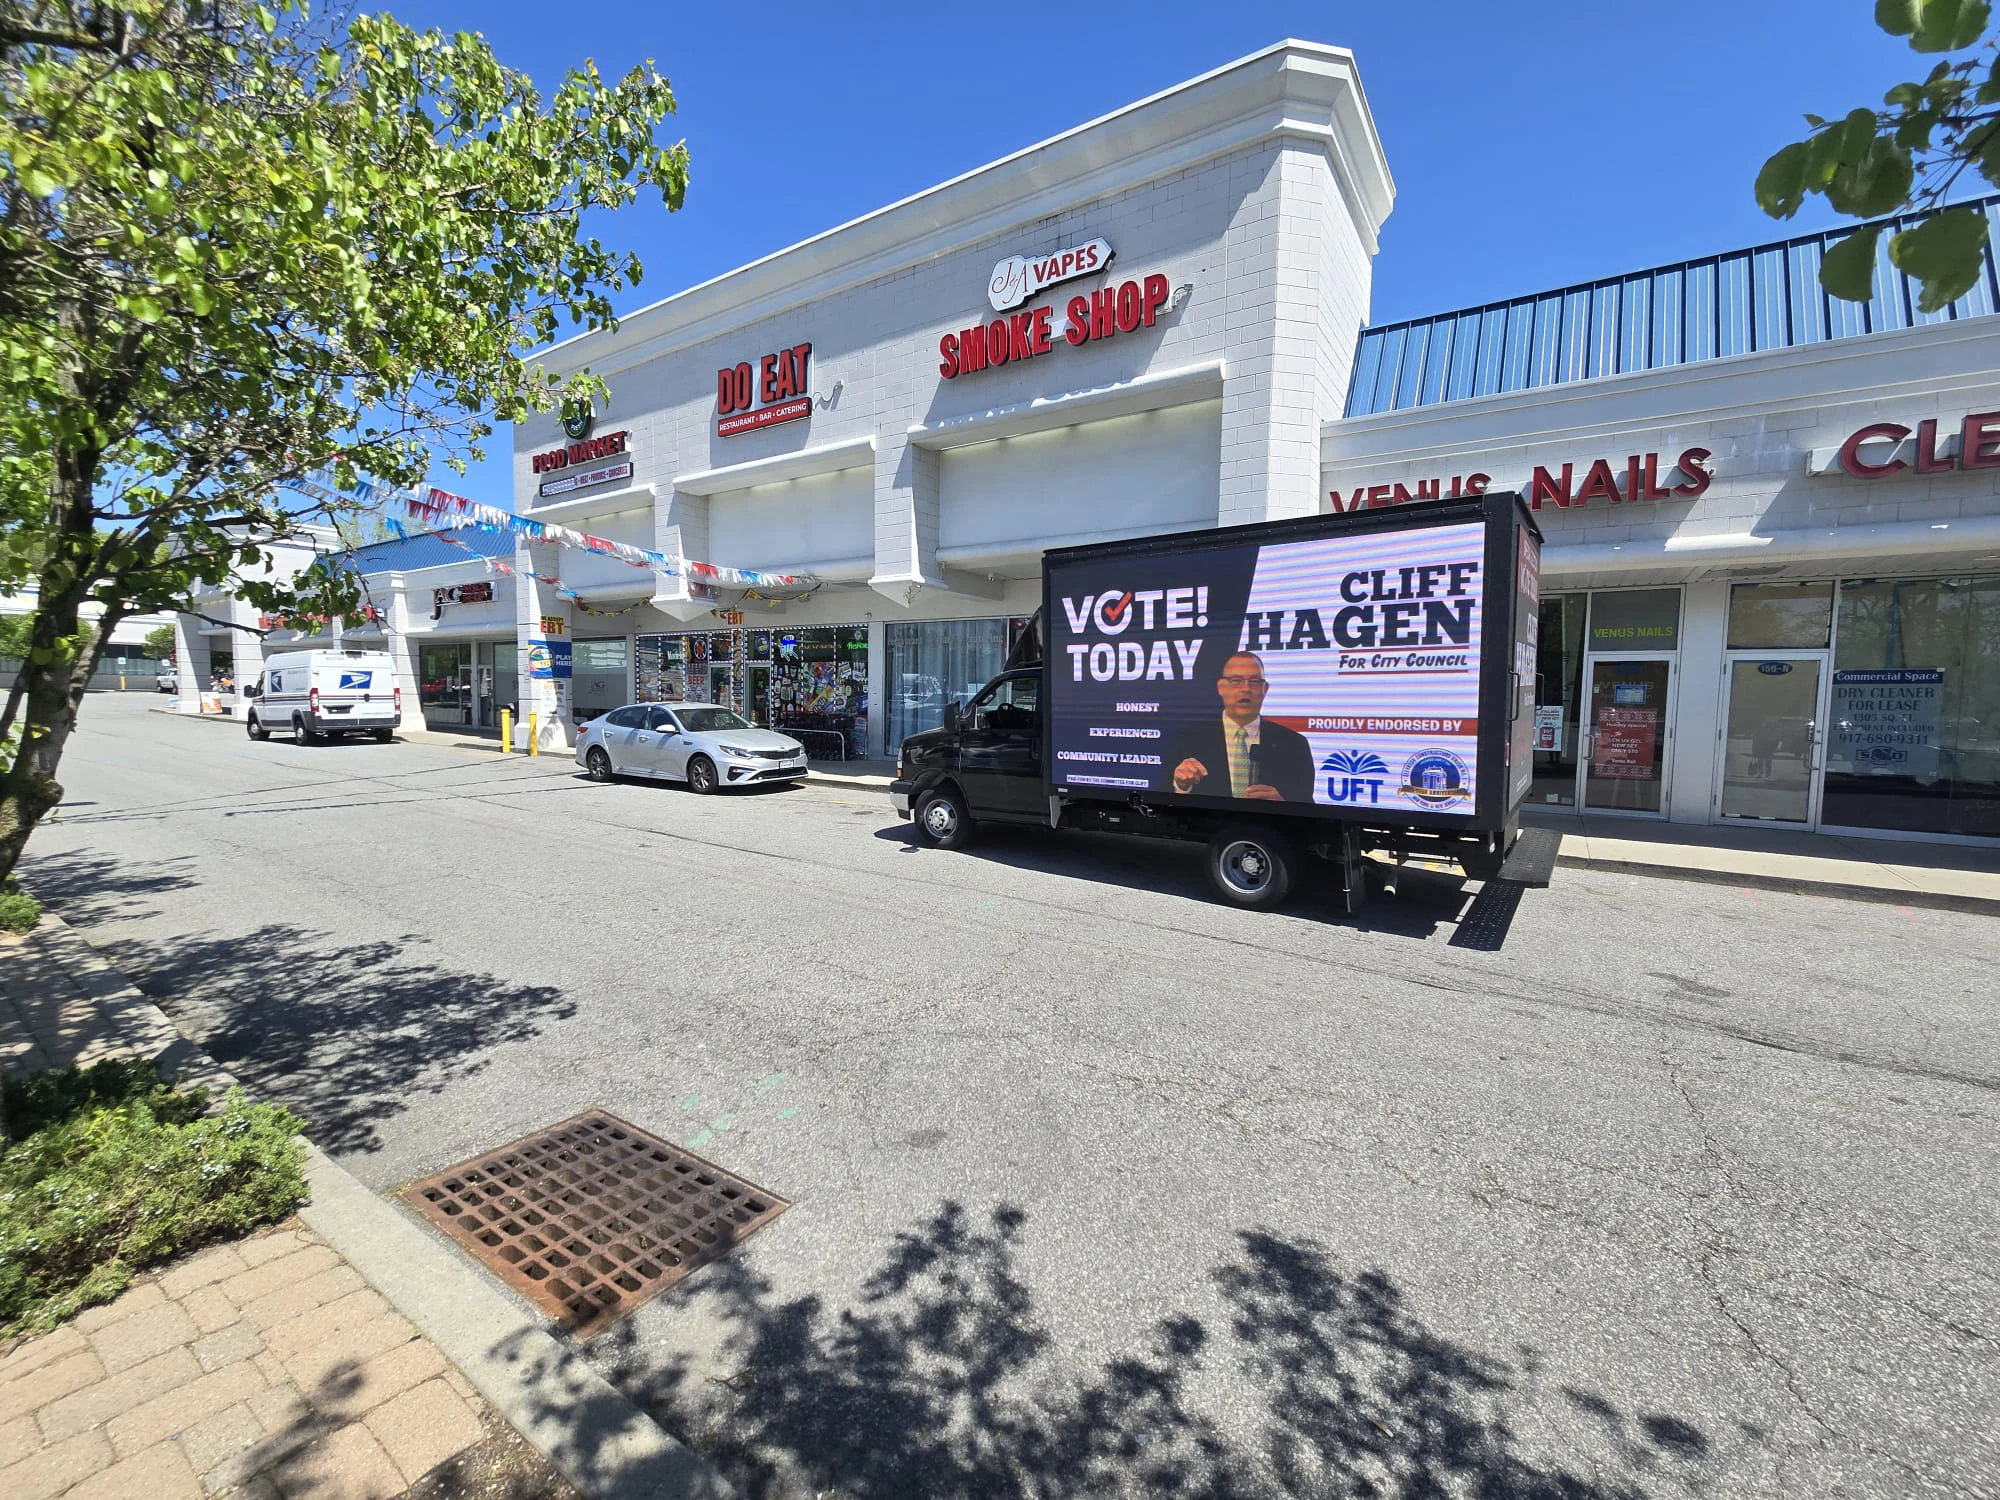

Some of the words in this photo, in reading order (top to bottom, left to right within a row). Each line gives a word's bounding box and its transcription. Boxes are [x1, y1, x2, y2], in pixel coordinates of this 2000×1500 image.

[991, 261, 1029, 304] J&A
[1033, 244, 1098, 283] VAPES
[939, 304, 1053, 380] SMOKE
[1065, 273, 1169, 346] SHOP
[718, 368, 753, 415] DO
[761, 342, 812, 403] EAT
[719, 416, 755, 432] RESTAURANT
[759, 412, 771, 421] BAR
[776, 403, 807, 416] CATERING
[533, 448, 568, 473] FOOD
[568, 431, 627, 465] MARKET
[1530, 447, 1714, 512] NAILS
[1339, 561, 1478, 603] CLIFF
[728, 611, 744, 625] EBT
[1062, 586, 1208, 635] VOTE!
[540, 621, 564, 634] EBT
[1244, 599, 1476, 650] HAGEN
[1594, 628, 1634, 638] VENUS
[1637, 626, 1673, 637] NAILS
[1066, 639, 1203, 682] TODAY
[1836, 672, 1901, 681] Commercial
[1904, 671, 1939, 682] Space
[1837, 688, 1868, 698] DRY
[1870, 688, 1935, 699] CLEANER
[1116, 702, 1159, 712] HONEST
[1848, 702, 1874, 711] FOR
[1878, 701, 1920, 711] LEASE
[1089, 727, 1161, 739] EXPERIENCED
[1308, 718, 1365, 730] PROUDLY
[1367, 719, 1440, 731] ENDORSED
[1442, 720, 1463, 732] BY
[1839, 733, 1928, 745] 917-680-9311
[1057, 751, 1119, 762] COMMUNITY
[1120, 754, 1162, 765] LEADER
[1327, 777, 1384, 803] UFT
